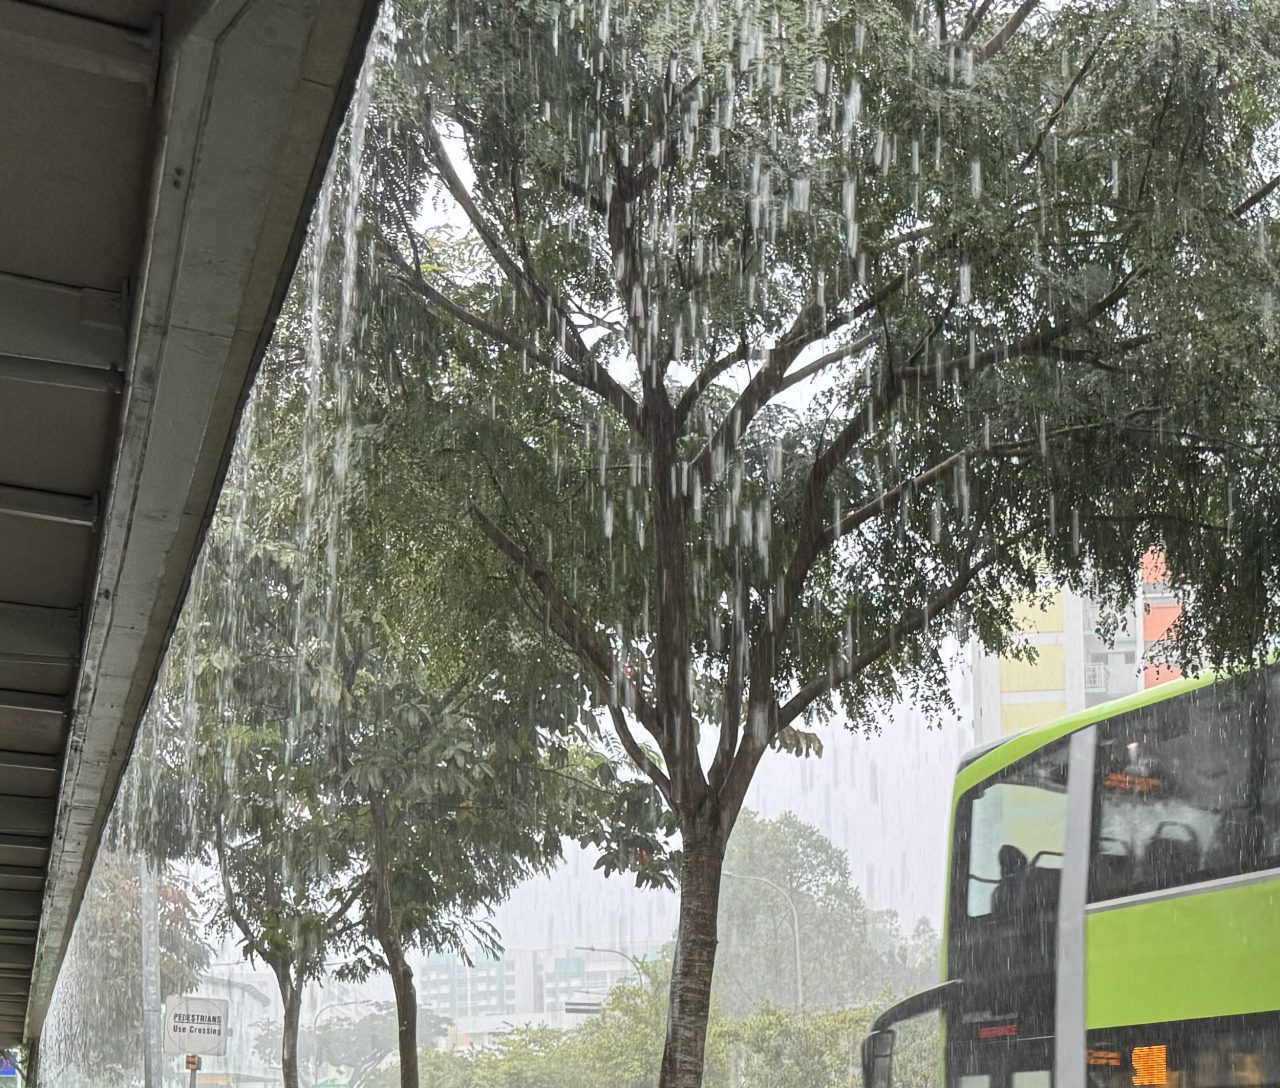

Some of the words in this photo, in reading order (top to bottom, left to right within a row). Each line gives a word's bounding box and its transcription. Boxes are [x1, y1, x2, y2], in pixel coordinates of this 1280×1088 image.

[174, 1013, 222, 1024] PEDESTRIANS
[173, 1025, 187, 1033] Use
[189, 1025, 222, 1036] Crossing
